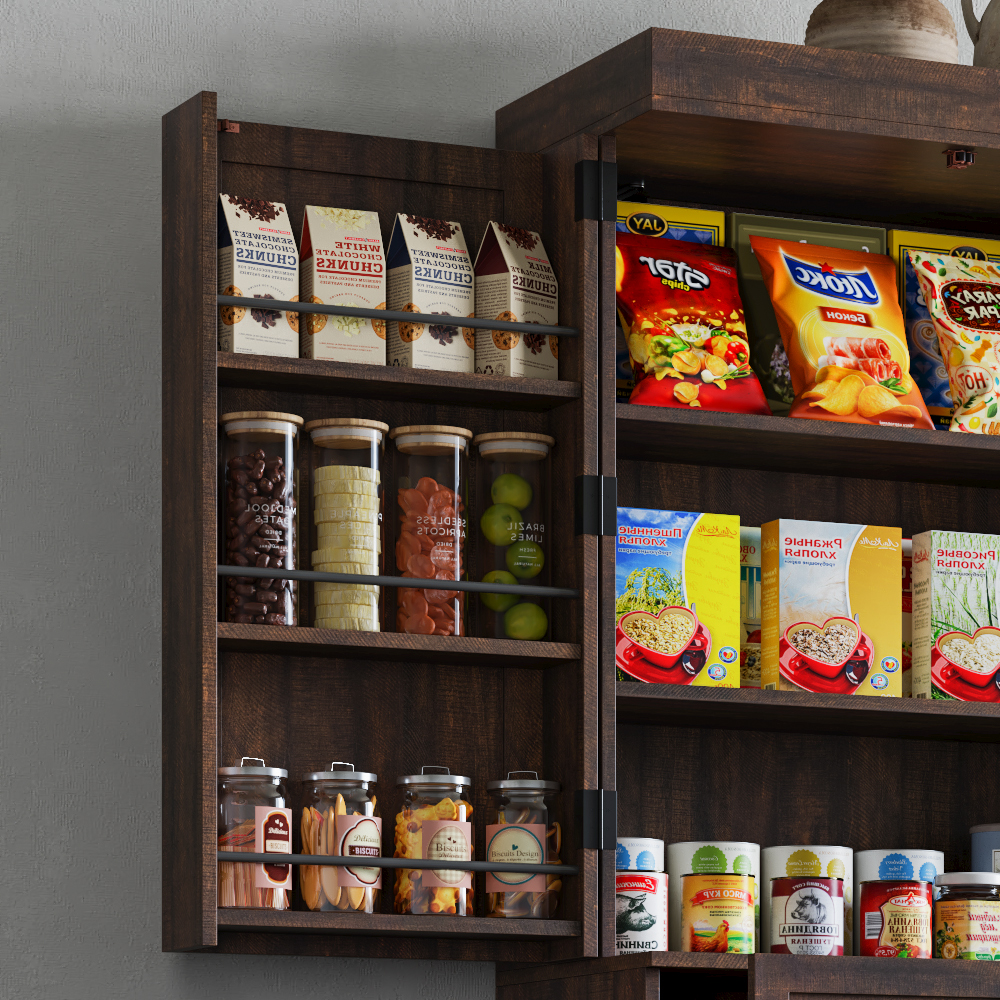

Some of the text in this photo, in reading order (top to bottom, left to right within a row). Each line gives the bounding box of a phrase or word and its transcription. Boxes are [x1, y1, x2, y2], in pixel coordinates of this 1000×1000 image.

[436, 843, 467, 853] Biscuits
[491, 850, 539, 858] Biscuits Design
